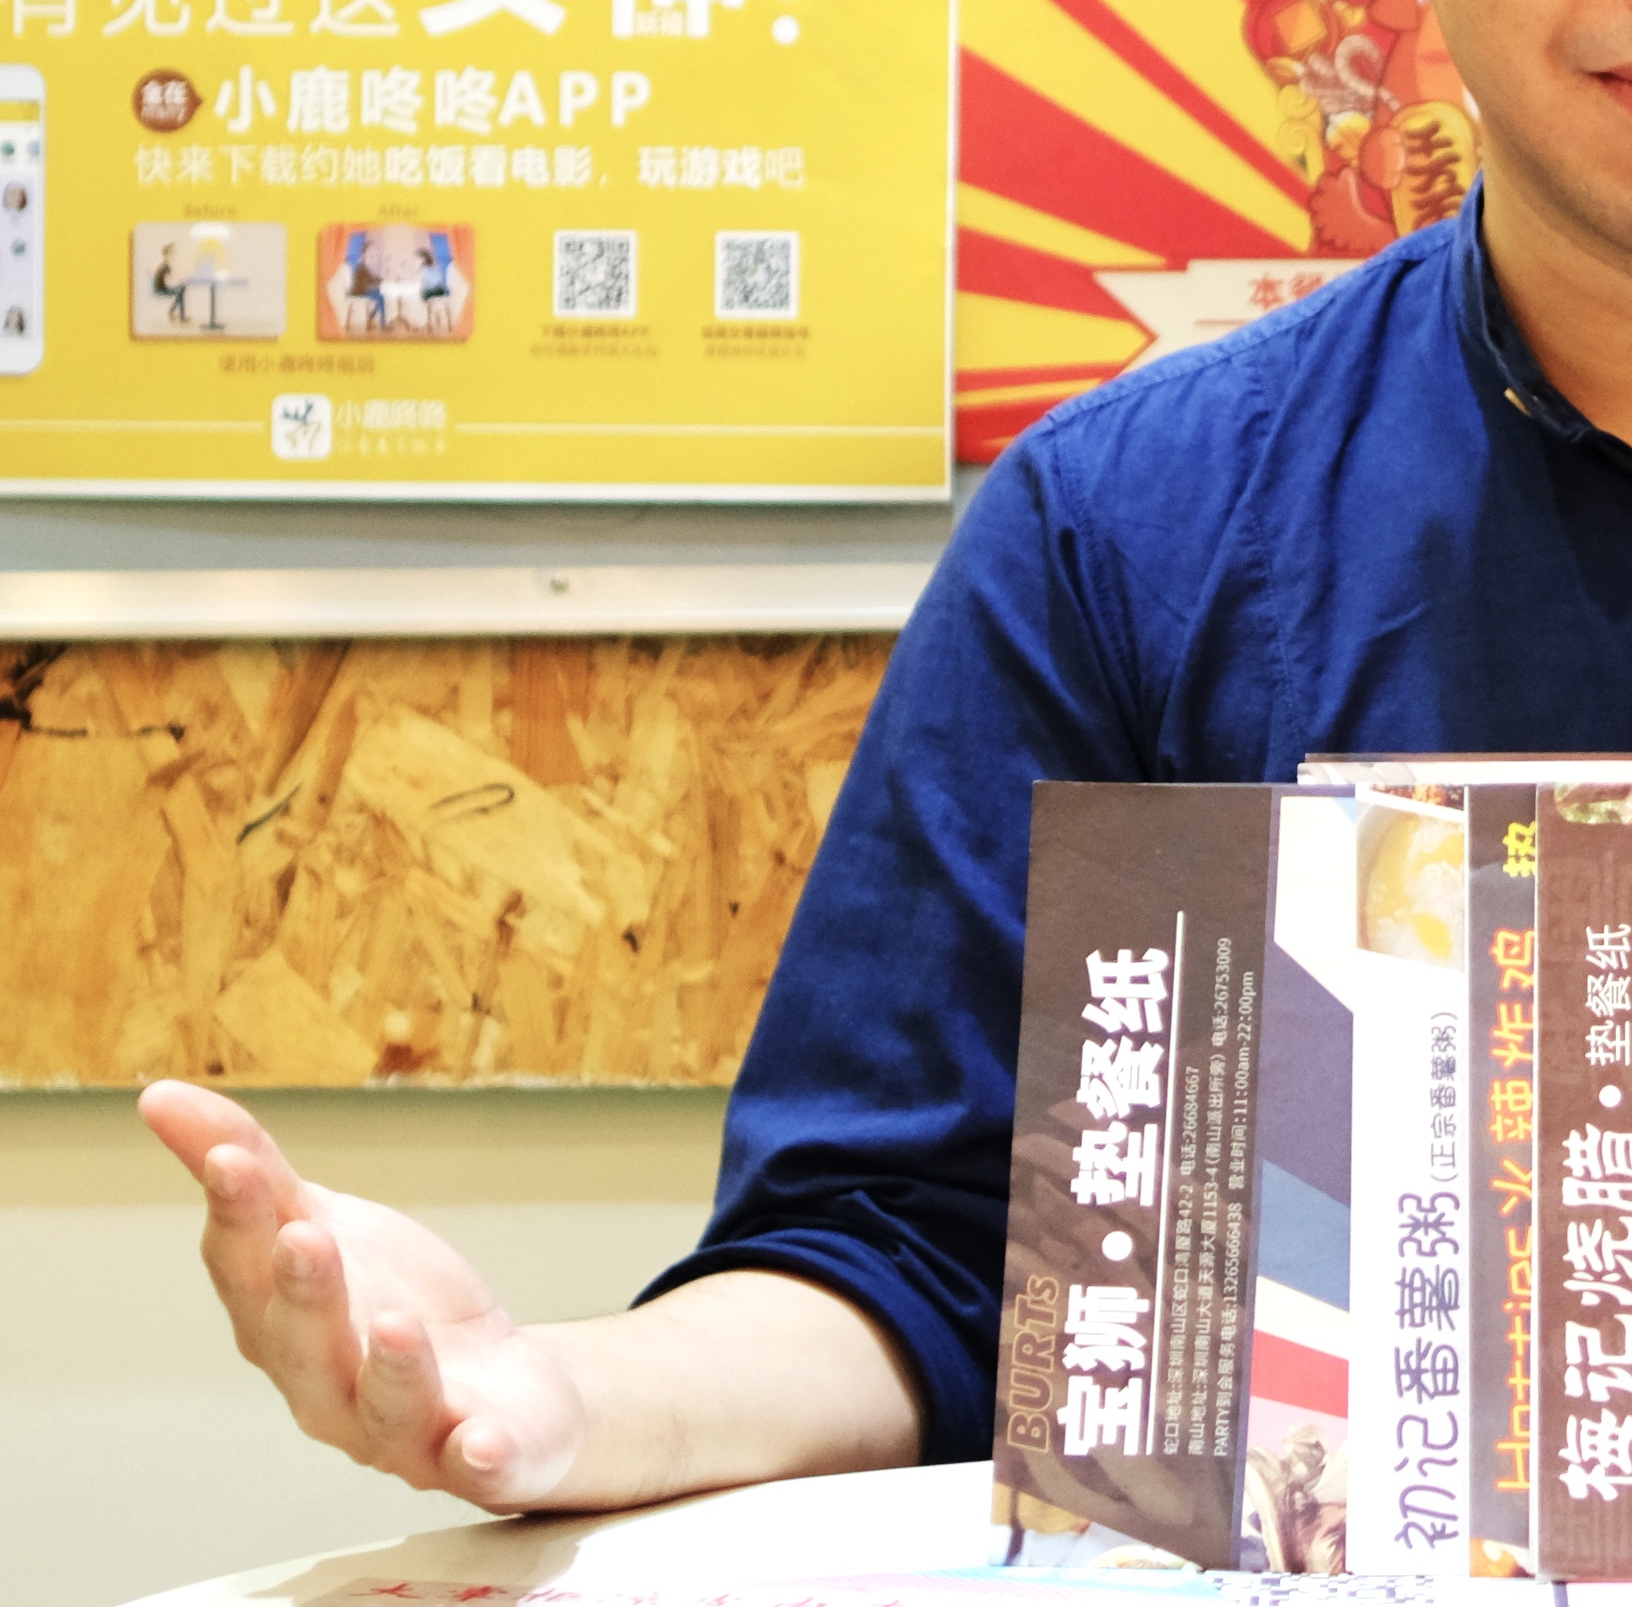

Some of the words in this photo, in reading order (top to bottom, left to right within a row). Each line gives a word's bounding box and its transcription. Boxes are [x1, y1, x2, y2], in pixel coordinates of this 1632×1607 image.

[212, 65, 653, 136] 小鹿咚咚APP
[1211, 936, 1233, 1047] 电话:26753009
[1179, 1064, 1202, 1177] 电话:26684667
[1394, 1191, 1461, 1551] 初记番薯粥
